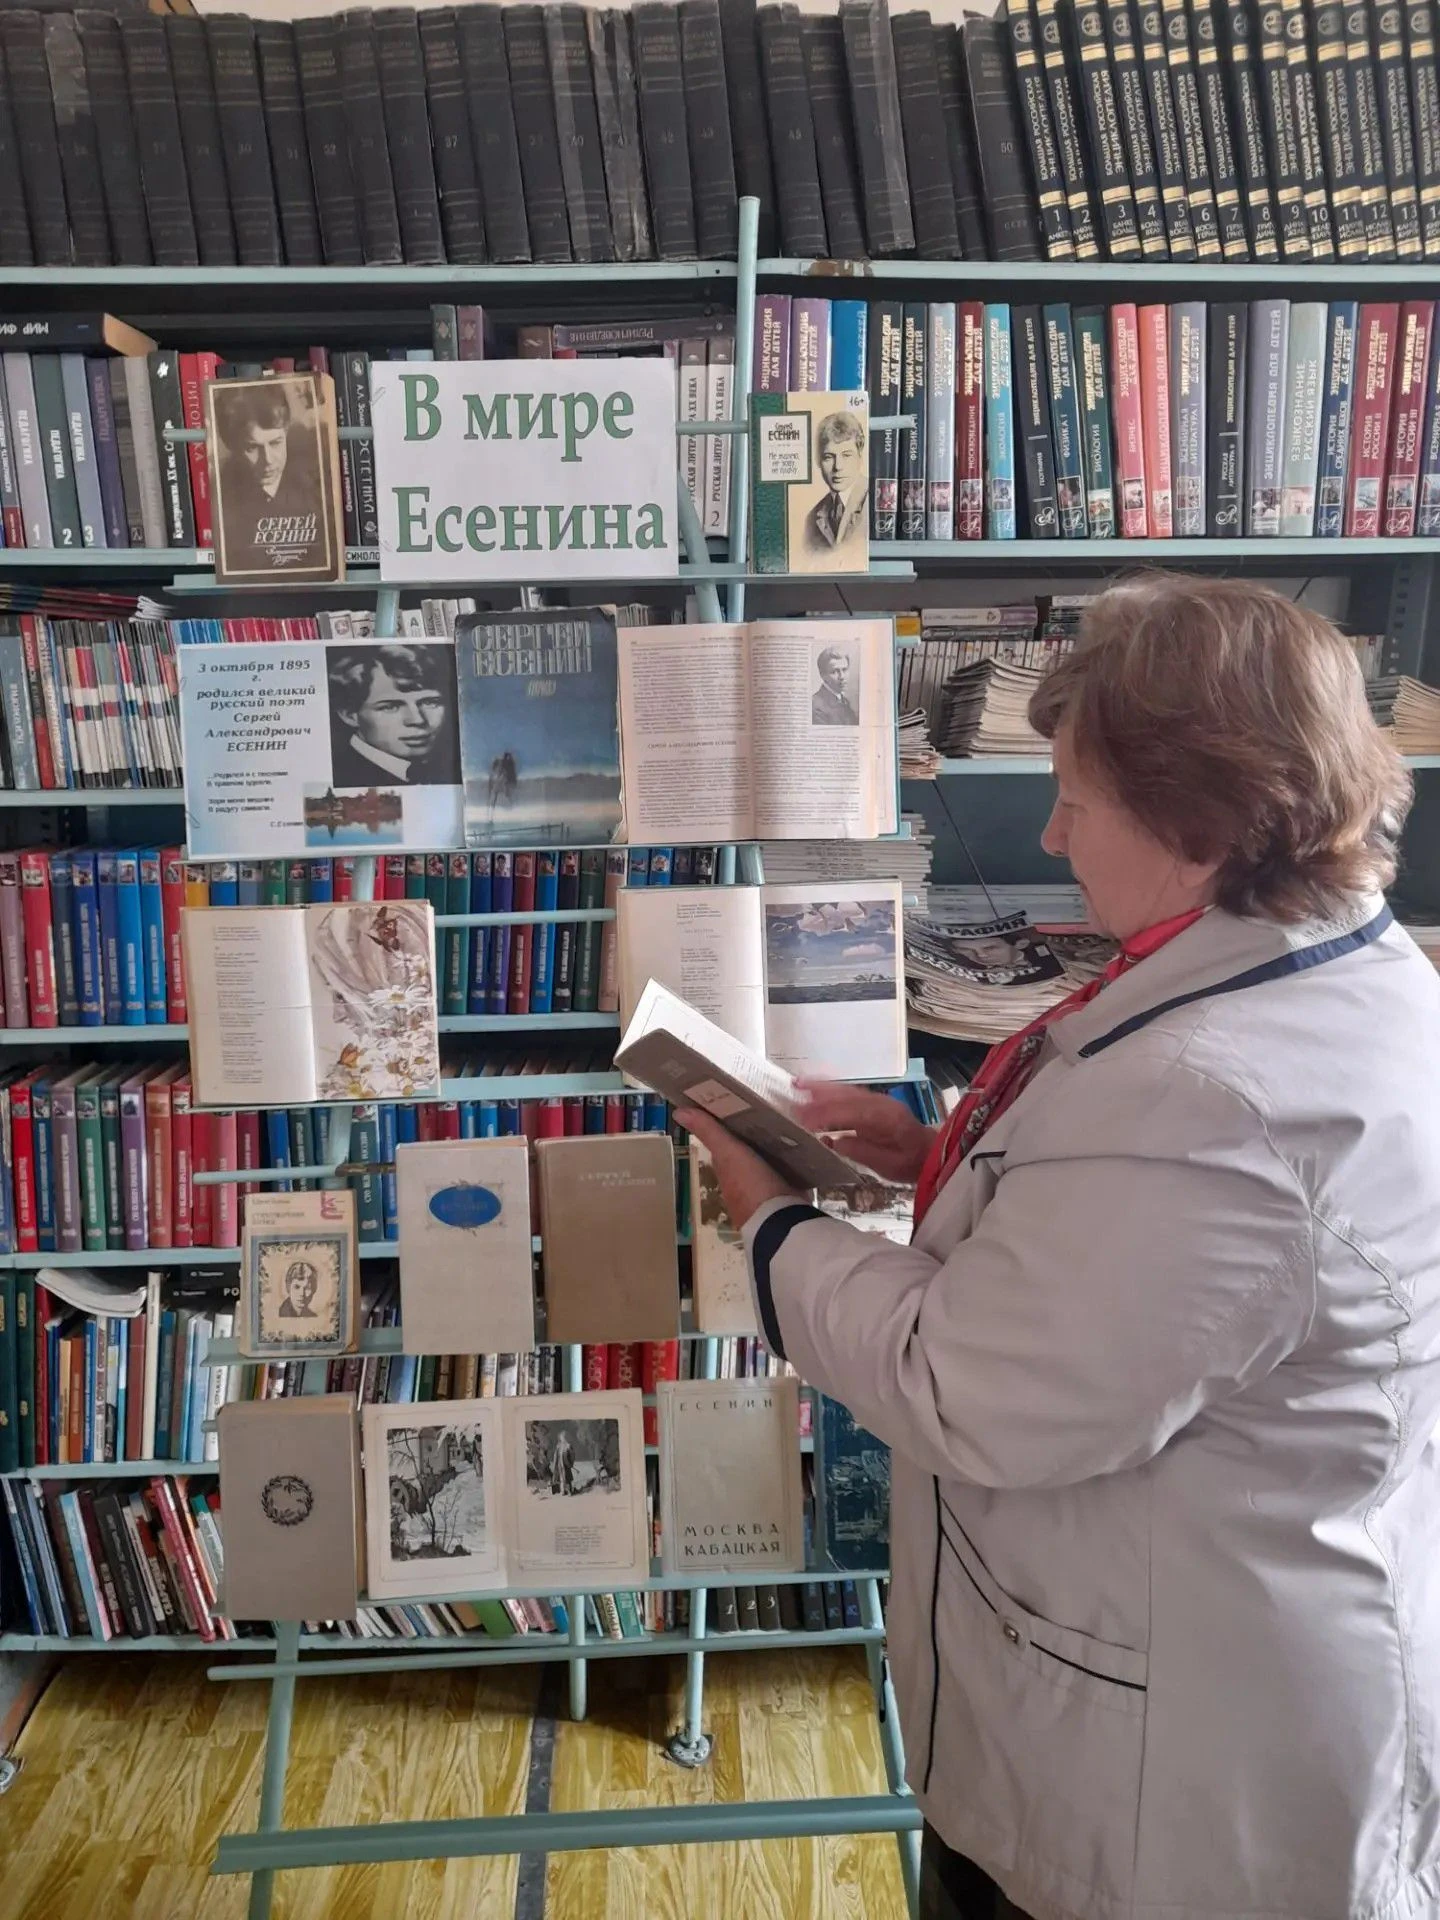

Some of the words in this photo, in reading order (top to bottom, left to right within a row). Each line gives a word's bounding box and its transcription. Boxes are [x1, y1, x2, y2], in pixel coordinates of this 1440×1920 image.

[1025, 78, 1040, 136] РОССИЙСКАЯ
[1055, 79, 1069, 137] РОССИЙСКАЯ
[1092, 72, 1106, 130] РОССИЙСКАЯ
[1122, 72, 1136, 130] РОССИЙСКАЯ
[1153, 71, 1166, 130] РОССИЙСКАЯ
[1178, 75, 1191, 134] РОССИЙСКАЯ
[1208, 75, 1220, 133] РОССИЙСКАЯ
[1241, 72, 1252, 132] РОССИЙСКАЯ
[1101, 70, 1124, 173] ЭНЦИКЛОПЕДИЯ
[1000, 142, 1012, 153] 50
[1036, 139, 1048, 181] БОЛЬШАЯ
[1065, 140, 1077, 181] БОЛЬШАЯ
[1100, 135, 1113, 176] БОЛЬШАЯ
[1131, 135, 1143, 175] БОЛЬШАЯ
[1161, 133, 1172, 174] БОЛЬШАЯ
[1186, 138, 1198, 179] БОЛЬШАЯ
[1216, 137, 1227, 178] БОЛЬШАЯ
[1248, 135, 1258, 178] БОЛЬШАЯ
[1054, 210, 1060, 222] 1
[1082, 210, 1090, 223] 2
[1119, 205, 1126, 218] 3
[1148, 204, 1155, 217] 4
[1178, 204, 1184, 218] 5
[1202, 208, 1210, 221] 6
[1232, 208, 1238, 221] 7
[1262, 207, 1270, 220] 8
[1292, 205, 1299, 218] 9
[1312, 208, 1328, 222] 10
[1342, 206, 1358, 221] 11
[1372, 204, 1387, 219] 12
[1402, 204, 1417, 219] 13
[23, 322, 49, 334] МИР
[770, 322, 781, 353] ДЕТЕЙ
[1025, 318, 1035, 342] ДЕТЕЙ
[1227, 315, 1236, 339] ДЕТЕЙ
[1269, 309, 1280, 347] ДЕТЕЙ
[760, 308, 773, 389] ЭНЦИКЛОПЕДИЯ
[905, 318, 914, 398] ЭНЦИКЛОПЕДИЯ
[914, 331, 923, 361] ДЕТЕЙ
[1028, 344, 1036, 360] ДЛЯ
[1048, 320, 1063, 400] ЭНЦИКЛОПЕДИЯ
[1058, 332, 1068, 362] ДЕТЕЙ
[771, 357, 781, 378] ДЛЯ
[915, 366, 924, 386] ДЛЯ
[1061, 366, 1070, 386] ДЛЯ
[1083, 332, 1096, 410] ЭНЦИКЛОПЕДИЯ
[1268, 353, 1278, 376] ДЛЯ
[1306, 360, 1317, 396] ЯЗЫК
[849, 397, 864, 406] 16+
[1030, 363, 1040, 425] ЭНЦИКЛОПЕДИЯ
[1226, 360, 1236, 423] ЭНЦИКЛОПЕДИЯ
[188, 381, 204, 462] РИТОРКА
[399, 374, 442, 441] В
[462, 391, 634, 462] мире
[1264, 382, 1279, 480] ЭНЦИКЛОПЕДИЯ
[1303, 400, 1315, 460] РУССКИЙ
[1327, 414, 1338, 455] ИСТОРИЯ
[18, 410, 34, 466] ПЕДАГОГИКА
[71, 412, 86, 462] ПЕДАГОГИКА
[768, 430, 800, 441] ЕСЕНИН
[968, 405, 976, 469] МОСКВОВЕДЕНИЕ
[1061, 420, 1071, 457] ФИЗИКА
[1092, 424, 1103, 472] БИОЛОГИЯ
[1128, 419, 1137, 452] БИЗНЕС
[1190, 409, 1199, 466] ЛИТЕРАТУРА
[1334, 430, 1346, 469] СРЕДНИХ
[1362, 415, 1373, 457] ИСТОРИЯ
[1371, 420, 1381, 459] РОССИИ
[1396, 413, 1407, 458] ИСТОРИЯ
[1406, 420, 1416, 462] РОССИИ
[50, 429, 66, 480] ПЕДАГОГИКА
[1036, 452, 1045, 486] ГЕОГРАФИЯ
[712, 466, 722, 502] РУССКАЯ
[257, 513, 316, 531] СЕРГЕЙ
[392, 486, 668, 552] Есенина
[712, 510, 720, 527] 2
[62, 527, 73, 546] 2
[254, 528, 317, 544] ЕСЕНИН
[472, 620, 592, 650] СЕРГЕЙ
[198, 664, 206, 673] 3
[210, 661, 274, 673] октября
[280, 660, 310, 670] 1895
[472, 648, 592, 676] ЕСЕНИН
[197, 688, 254, 700] родился
[258, 685, 316, 697] великий
[210, 698, 265, 711] русский
[269, 698, 305, 707] поэт
[204, 727, 311, 738] Александрович
[233, 712, 281, 724] Сергей
[226, 740, 287, 752] ЕСЕНИН
[680, 1398, 773, 1412] ЕСЕНИН
[685, 1523, 780, 1537] МОСКВА
[685, 1541, 781, 1557] КАБАЦКАЯ
[726, 1604, 734, 1615] 1
[747, 1600, 755, 1610] 2
